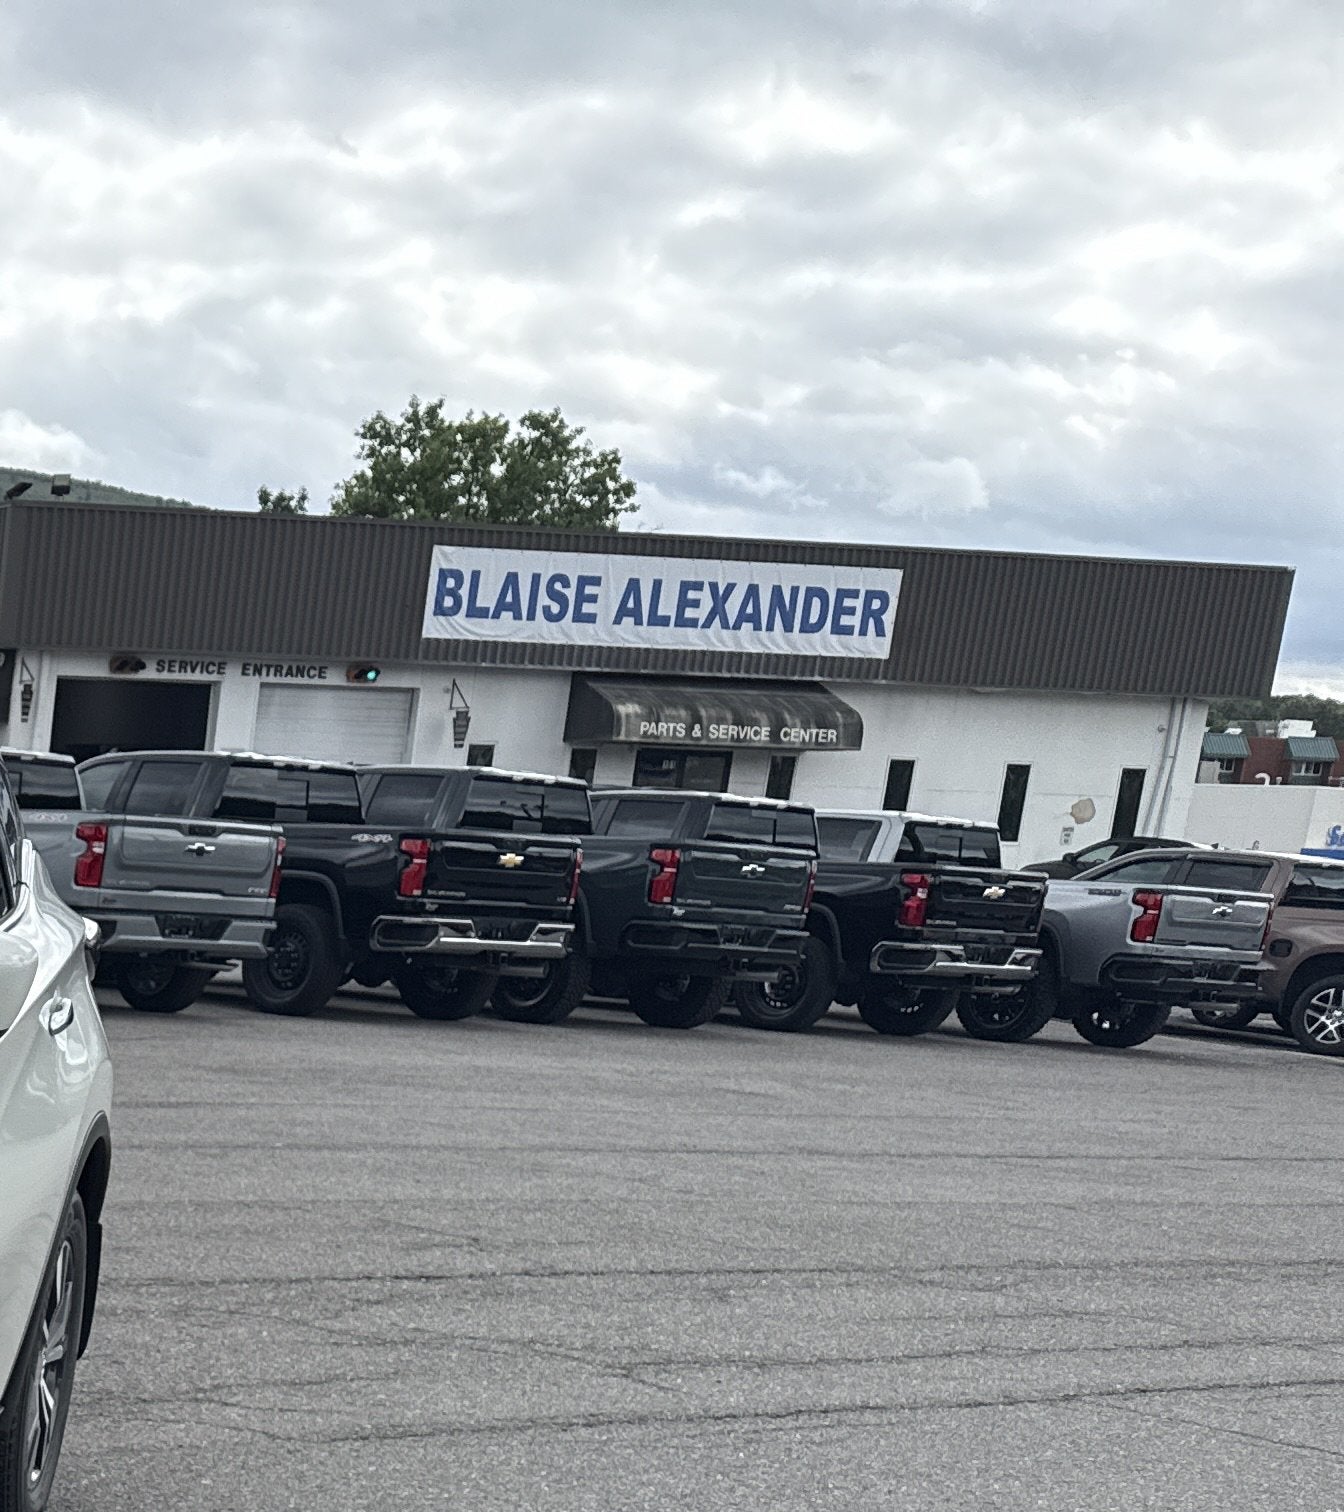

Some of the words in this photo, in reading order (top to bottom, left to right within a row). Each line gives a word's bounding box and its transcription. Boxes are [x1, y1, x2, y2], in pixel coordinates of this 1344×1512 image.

[432, 567, 602, 625] BLAISE
[612, 577, 891, 638] ALEXANDER
[155, 659, 228, 676] SERVICE
[241, 662, 328, 680] ENTRANCE
[640, 721, 687, 738] PARTS
[691, 723, 702, 739] &
[708, 724, 771, 742] SERVICE
[779, 726, 839, 744] CENTER
